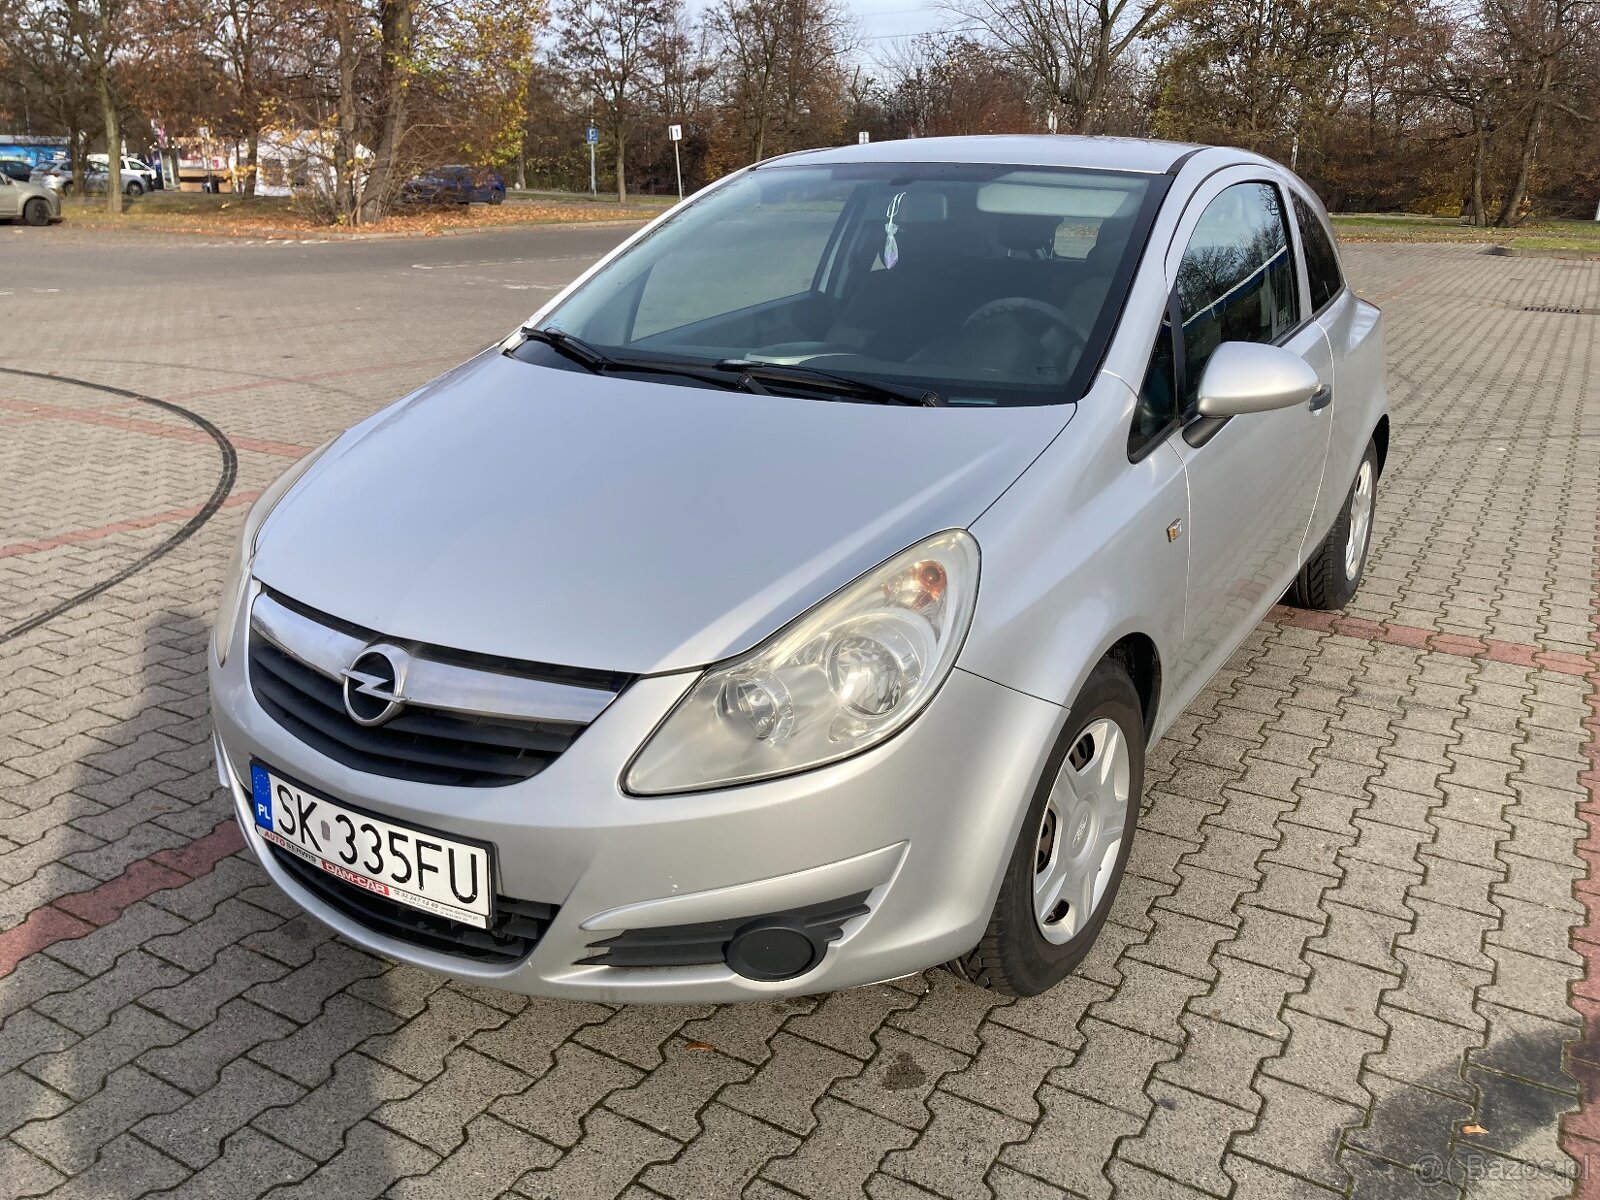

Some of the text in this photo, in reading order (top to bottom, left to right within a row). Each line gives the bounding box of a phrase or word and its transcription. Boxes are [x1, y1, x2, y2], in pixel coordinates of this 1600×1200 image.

[257, 802, 271, 820] PL
[277, 784, 479, 904] SK 335FU
[325, 862, 386, 894] DAM-CAR
